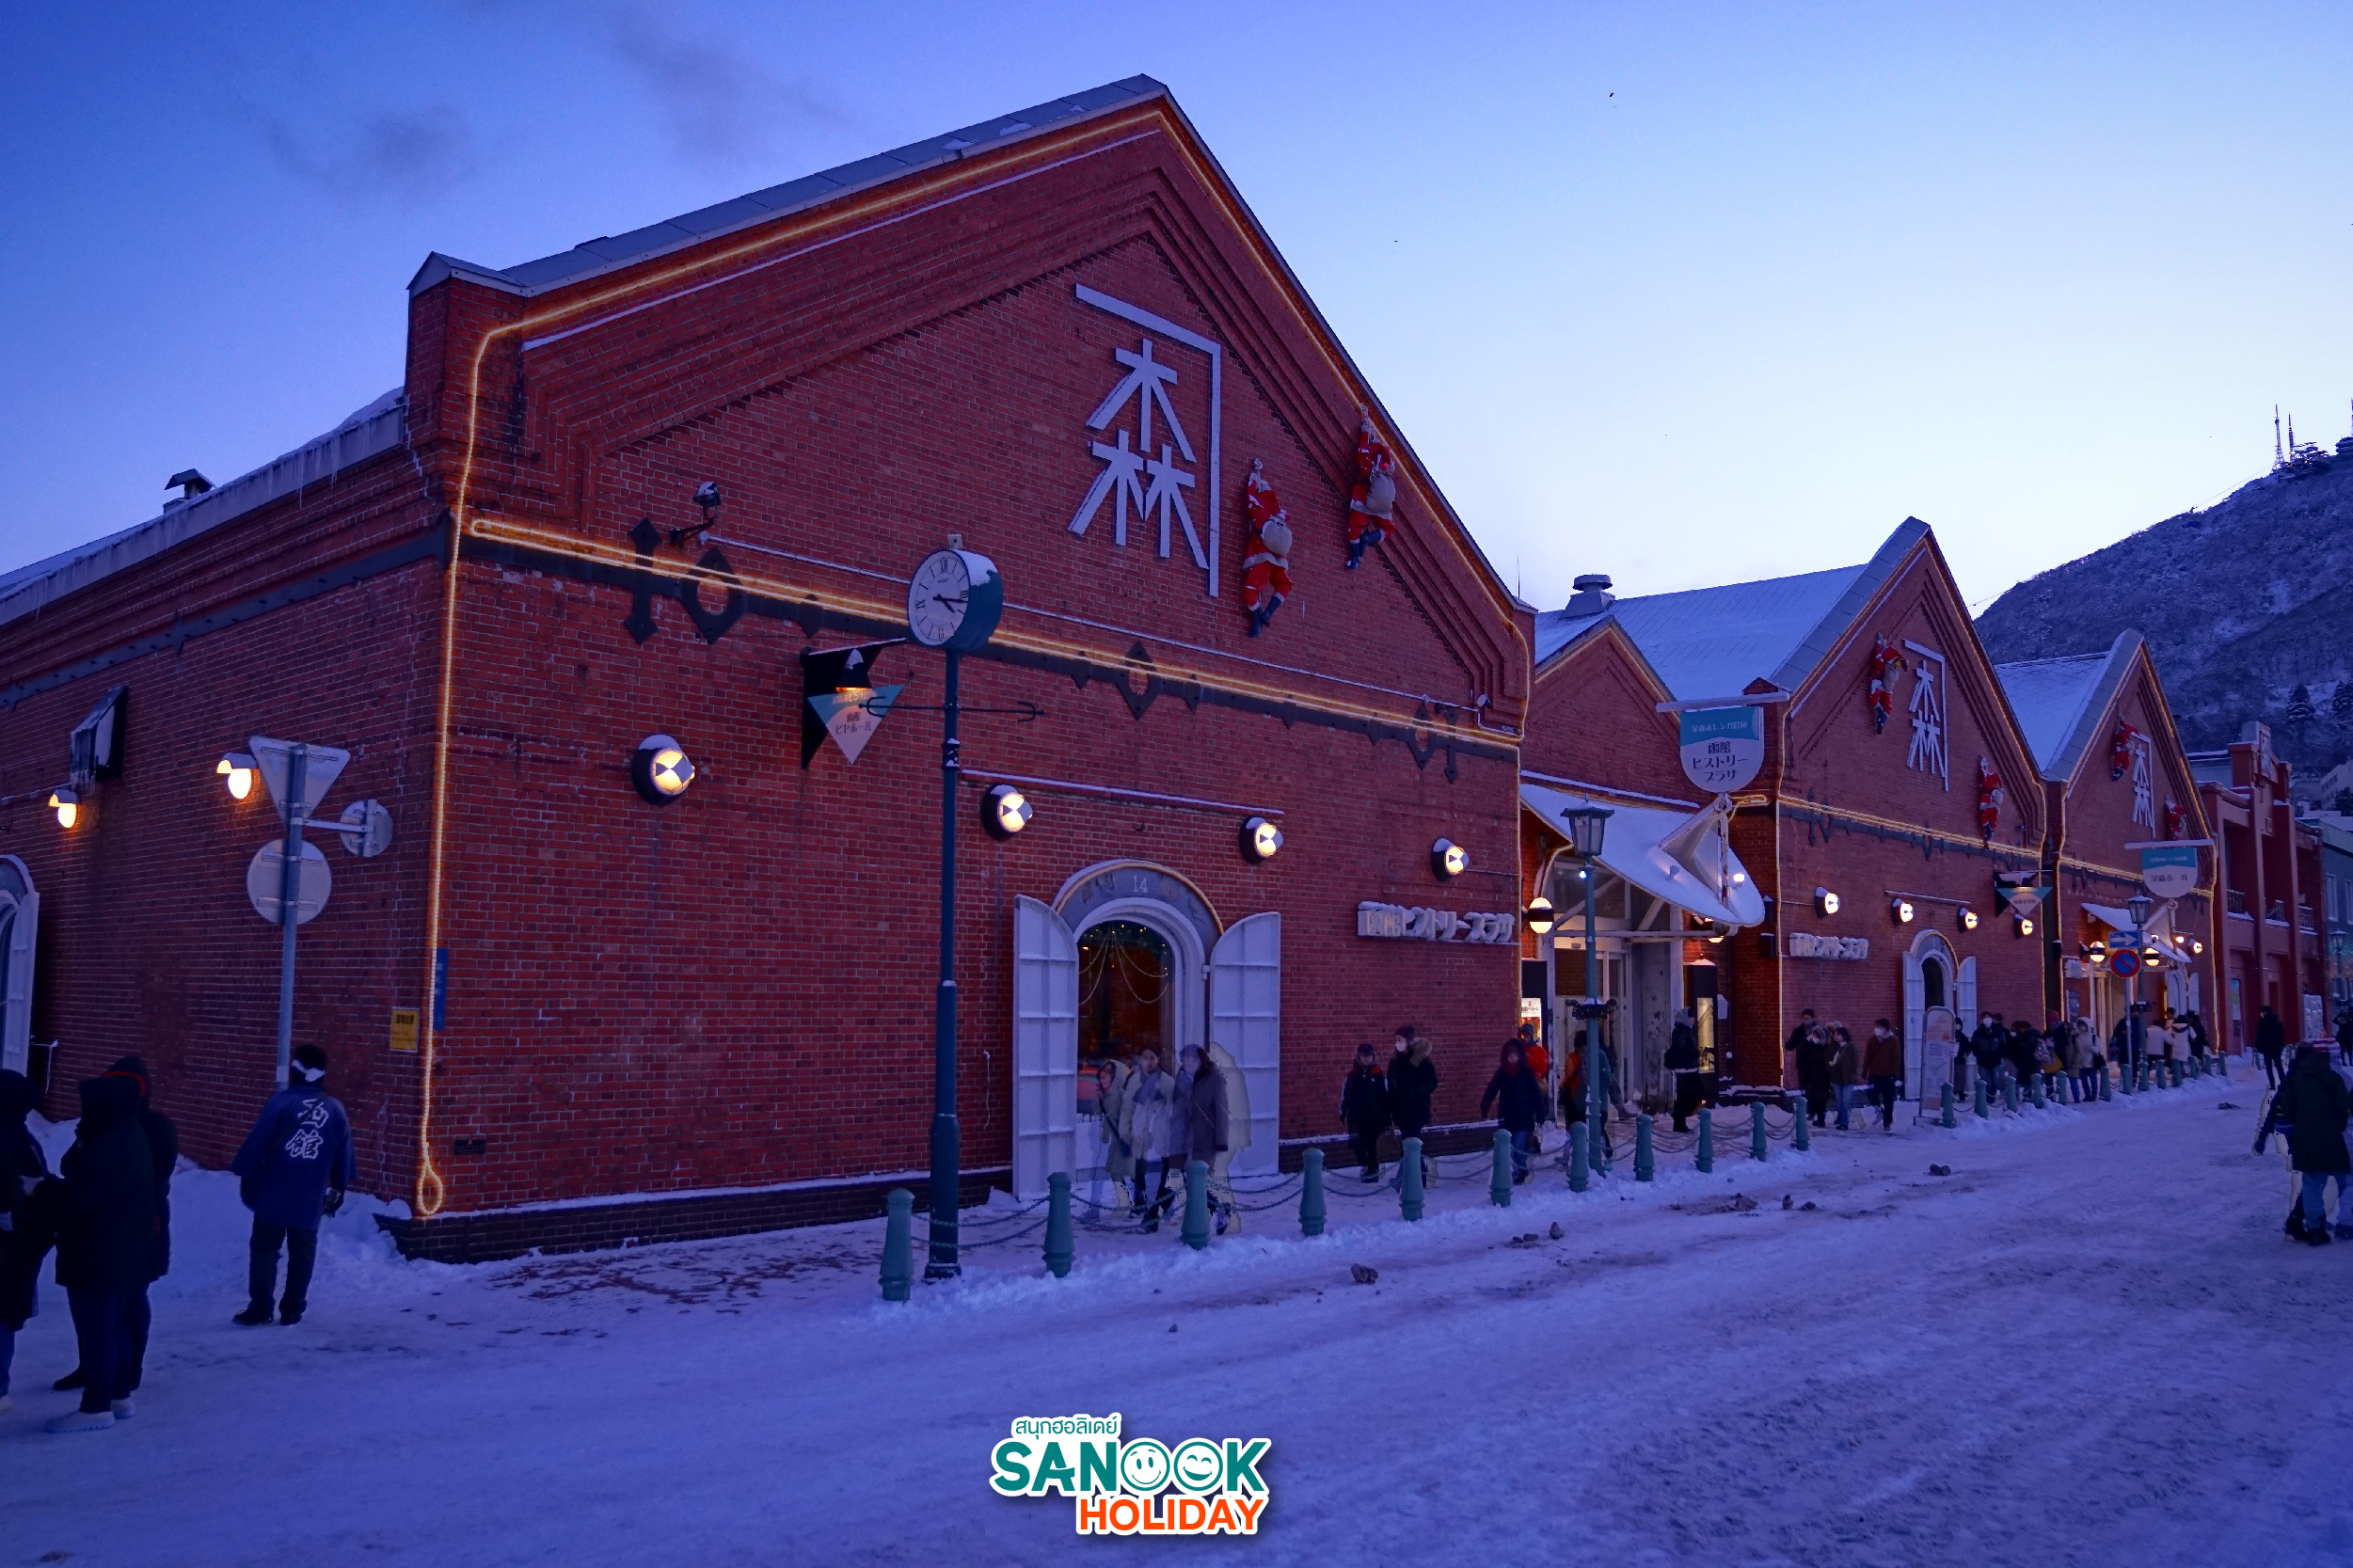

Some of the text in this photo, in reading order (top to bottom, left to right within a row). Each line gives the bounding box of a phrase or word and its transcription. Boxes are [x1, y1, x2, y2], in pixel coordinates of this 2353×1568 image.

[1708, 741, 1731, 754] 函館
[1693, 754, 1748, 769] ヒストリー
[1703, 768, 1738, 783] プラザ
[1135, 875, 1149, 894] 14
